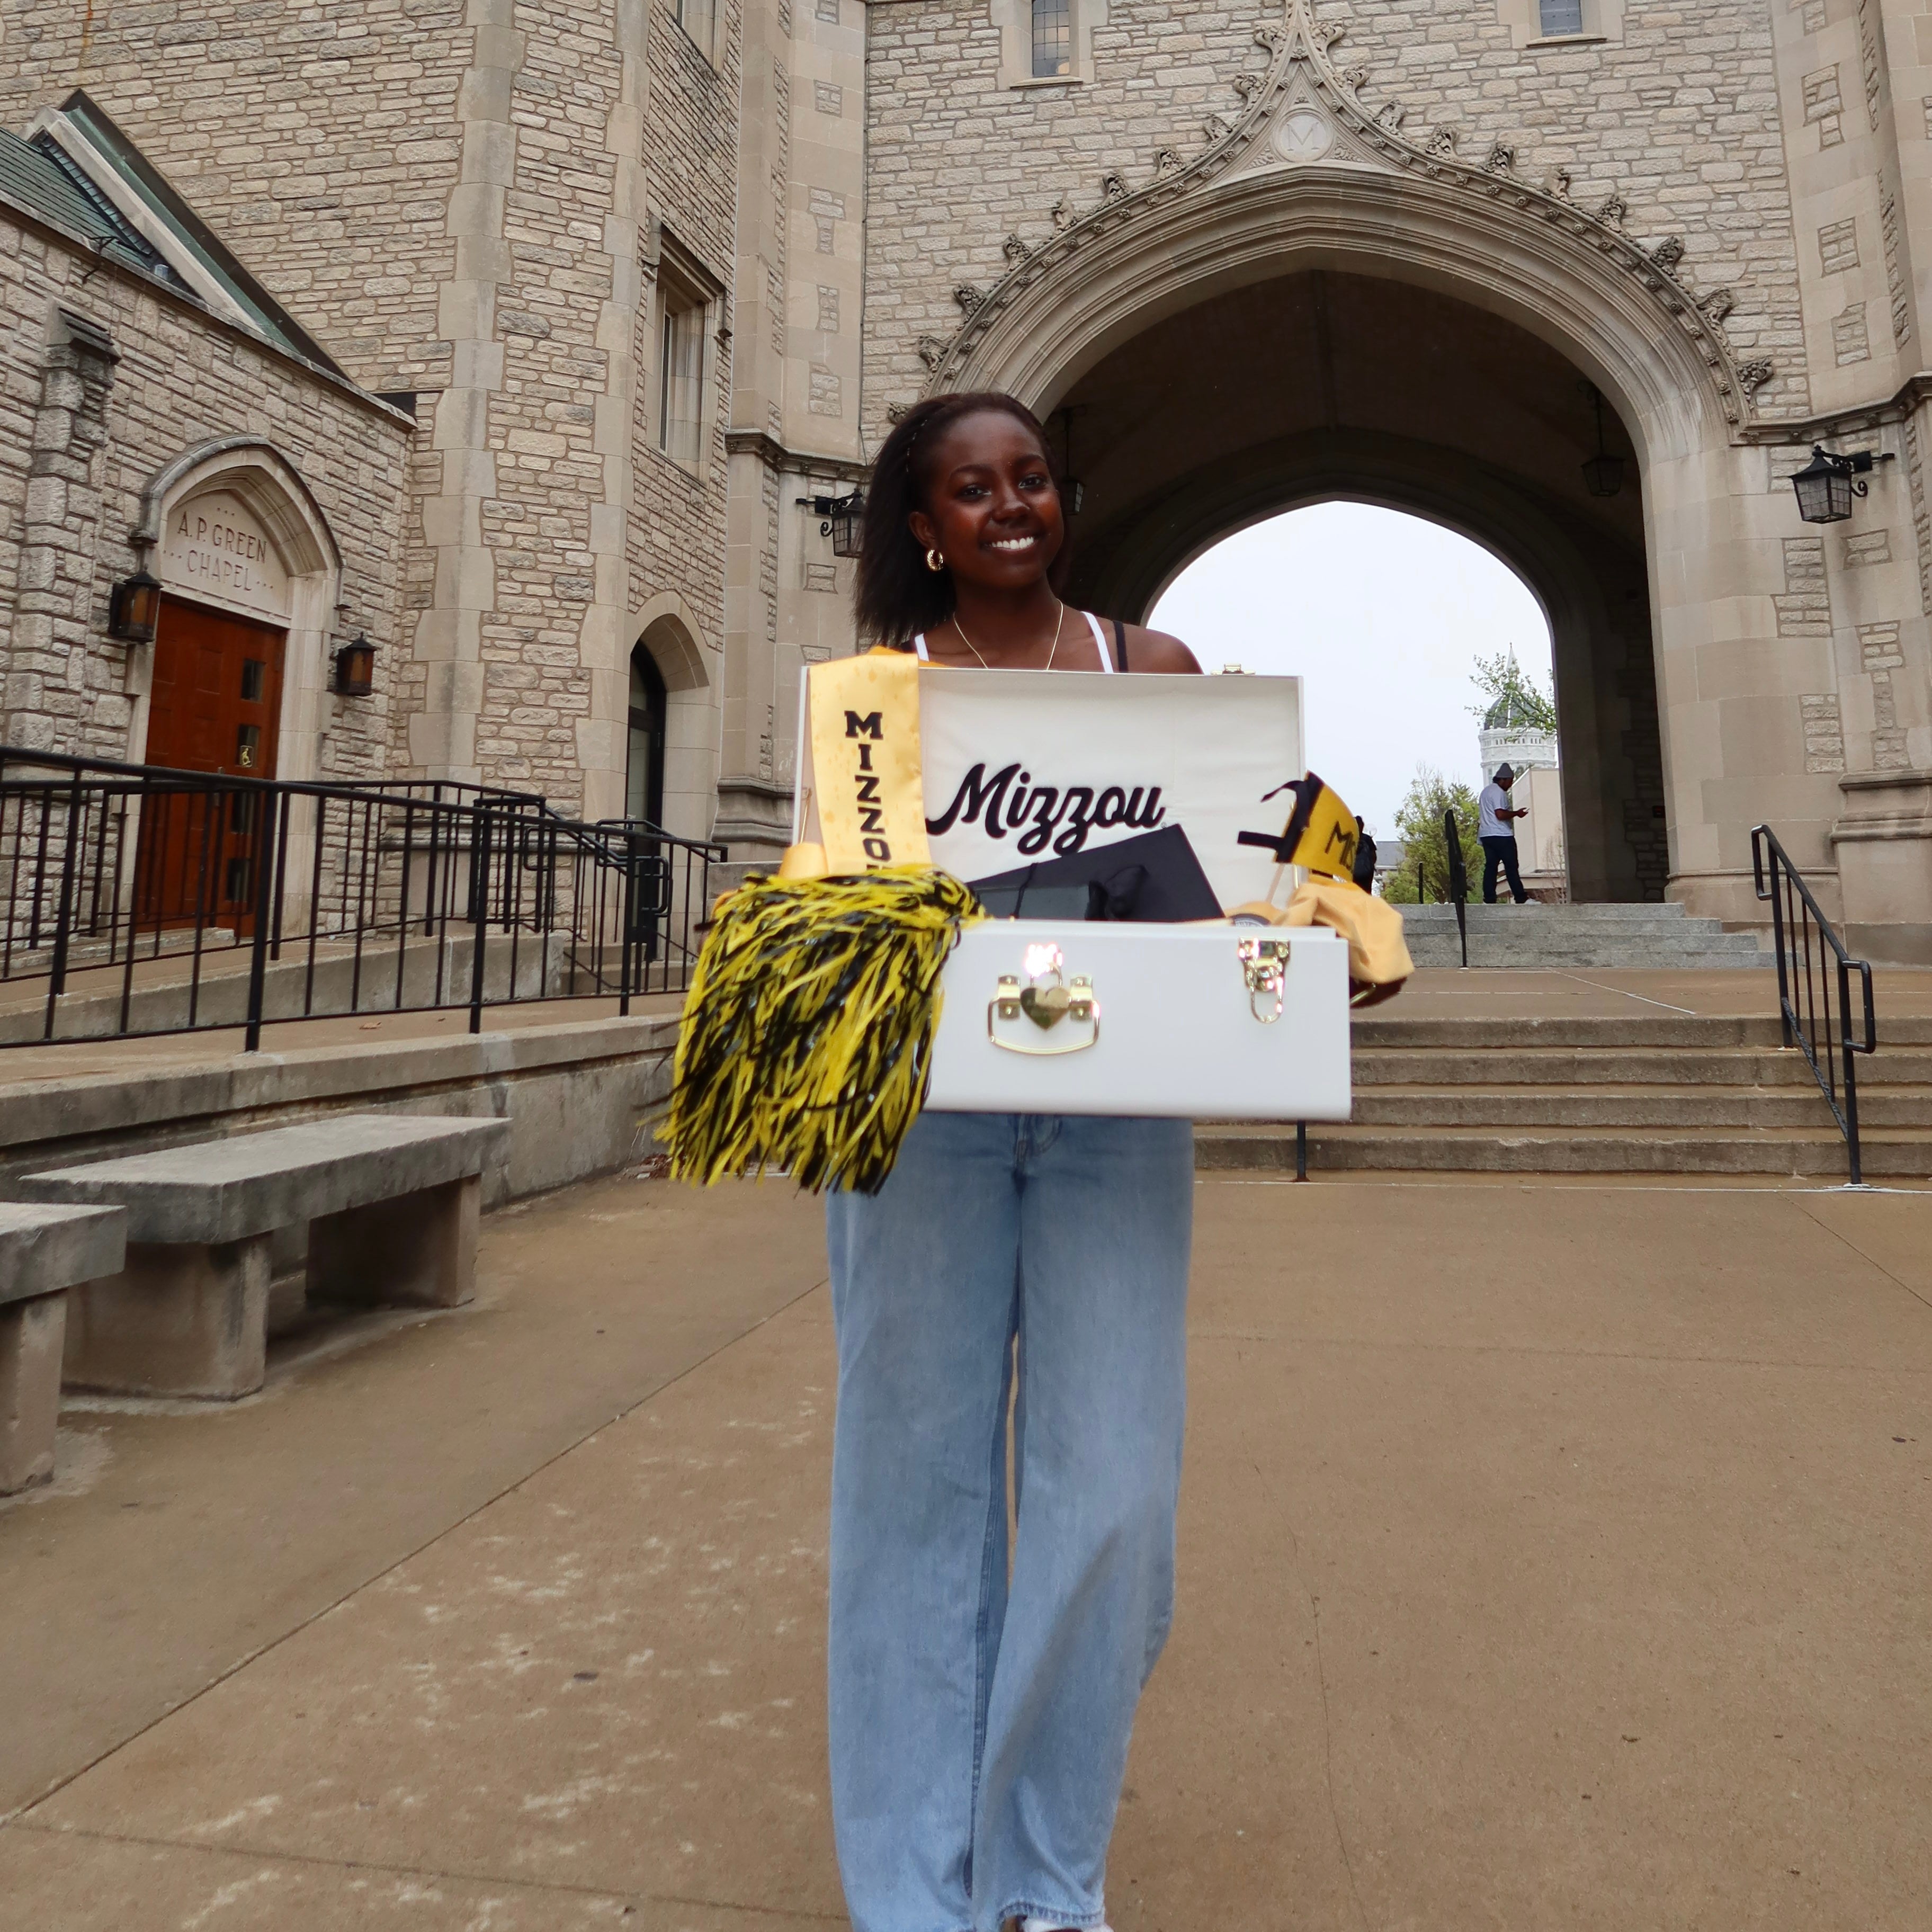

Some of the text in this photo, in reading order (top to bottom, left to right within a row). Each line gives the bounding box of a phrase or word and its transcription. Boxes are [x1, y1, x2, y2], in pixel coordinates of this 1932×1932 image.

[1286, 122, 1319, 151] M
[212, 524, 267, 564] GREEN
[187, 549, 252, 592] CHAPEL
[844, 710, 895, 871] MIZZO
[925, 763, 1166, 856] Mizzou
